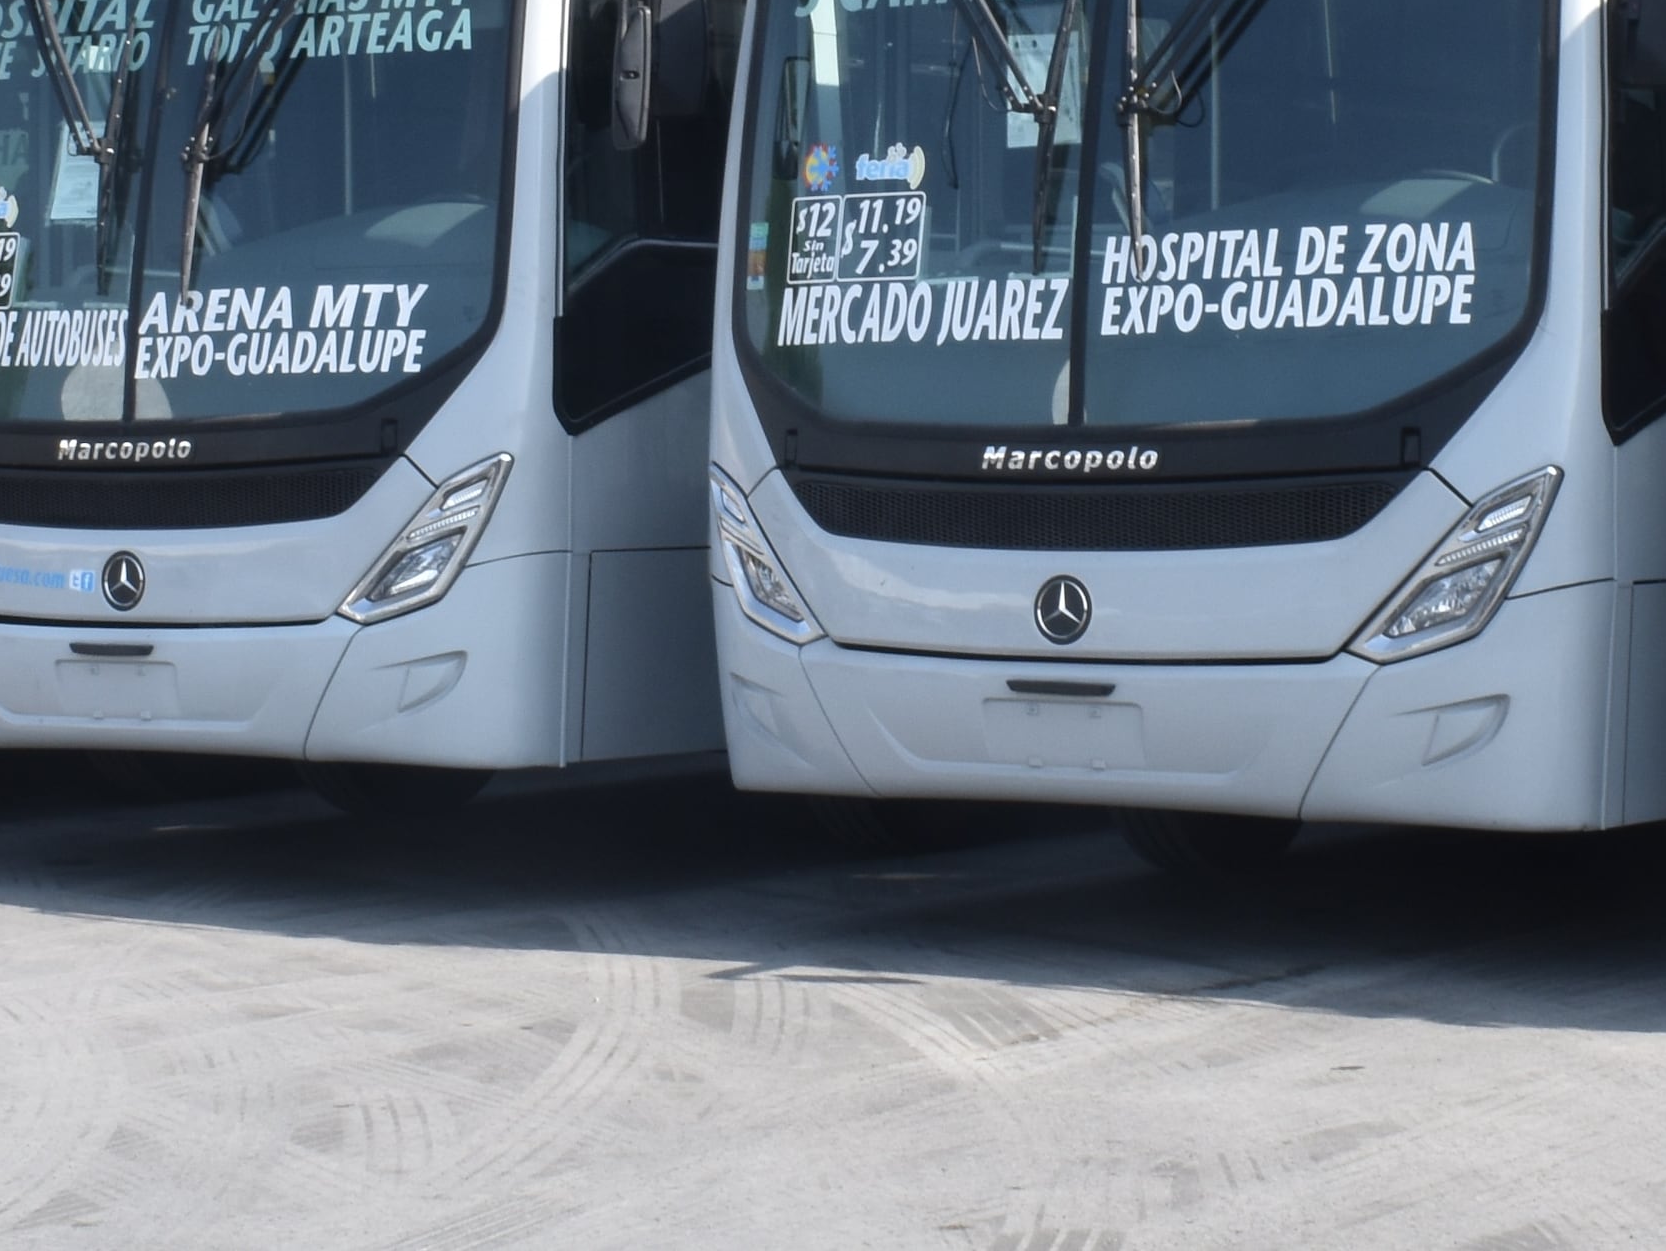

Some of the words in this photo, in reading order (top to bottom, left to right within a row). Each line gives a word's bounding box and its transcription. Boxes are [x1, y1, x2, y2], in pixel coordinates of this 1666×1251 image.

[290, 8, 473, 58] ARTEAGA
[796, 202, 836, 237] $12
[859, 197, 922, 234] 11.19
[792, 252, 835, 279] Tarjeta
[855, 238, 918, 275] 7.39
[1101, 228, 1283, 284] HOSPITAL
[1294, 225, 1348, 276] DE
[1357, 221, 1476, 274] ZONA
[139, 286, 295, 335] ARENA
[309, 283, 429, 330] MTY
[777, 282, 932, 347] MERCADO
[937, 278, 1070, 347] JUAREZ
[1100, 274, 1475, 336] EXPO-GUADALUPE
[15, 309, 129, 367] AUTOBUSES
[134, 329, 427, 380] EXPO-GUADALUPE
[58, 439, 192, 462] Marcopolo
[982, 445, 1159, 474] Marcopolo
